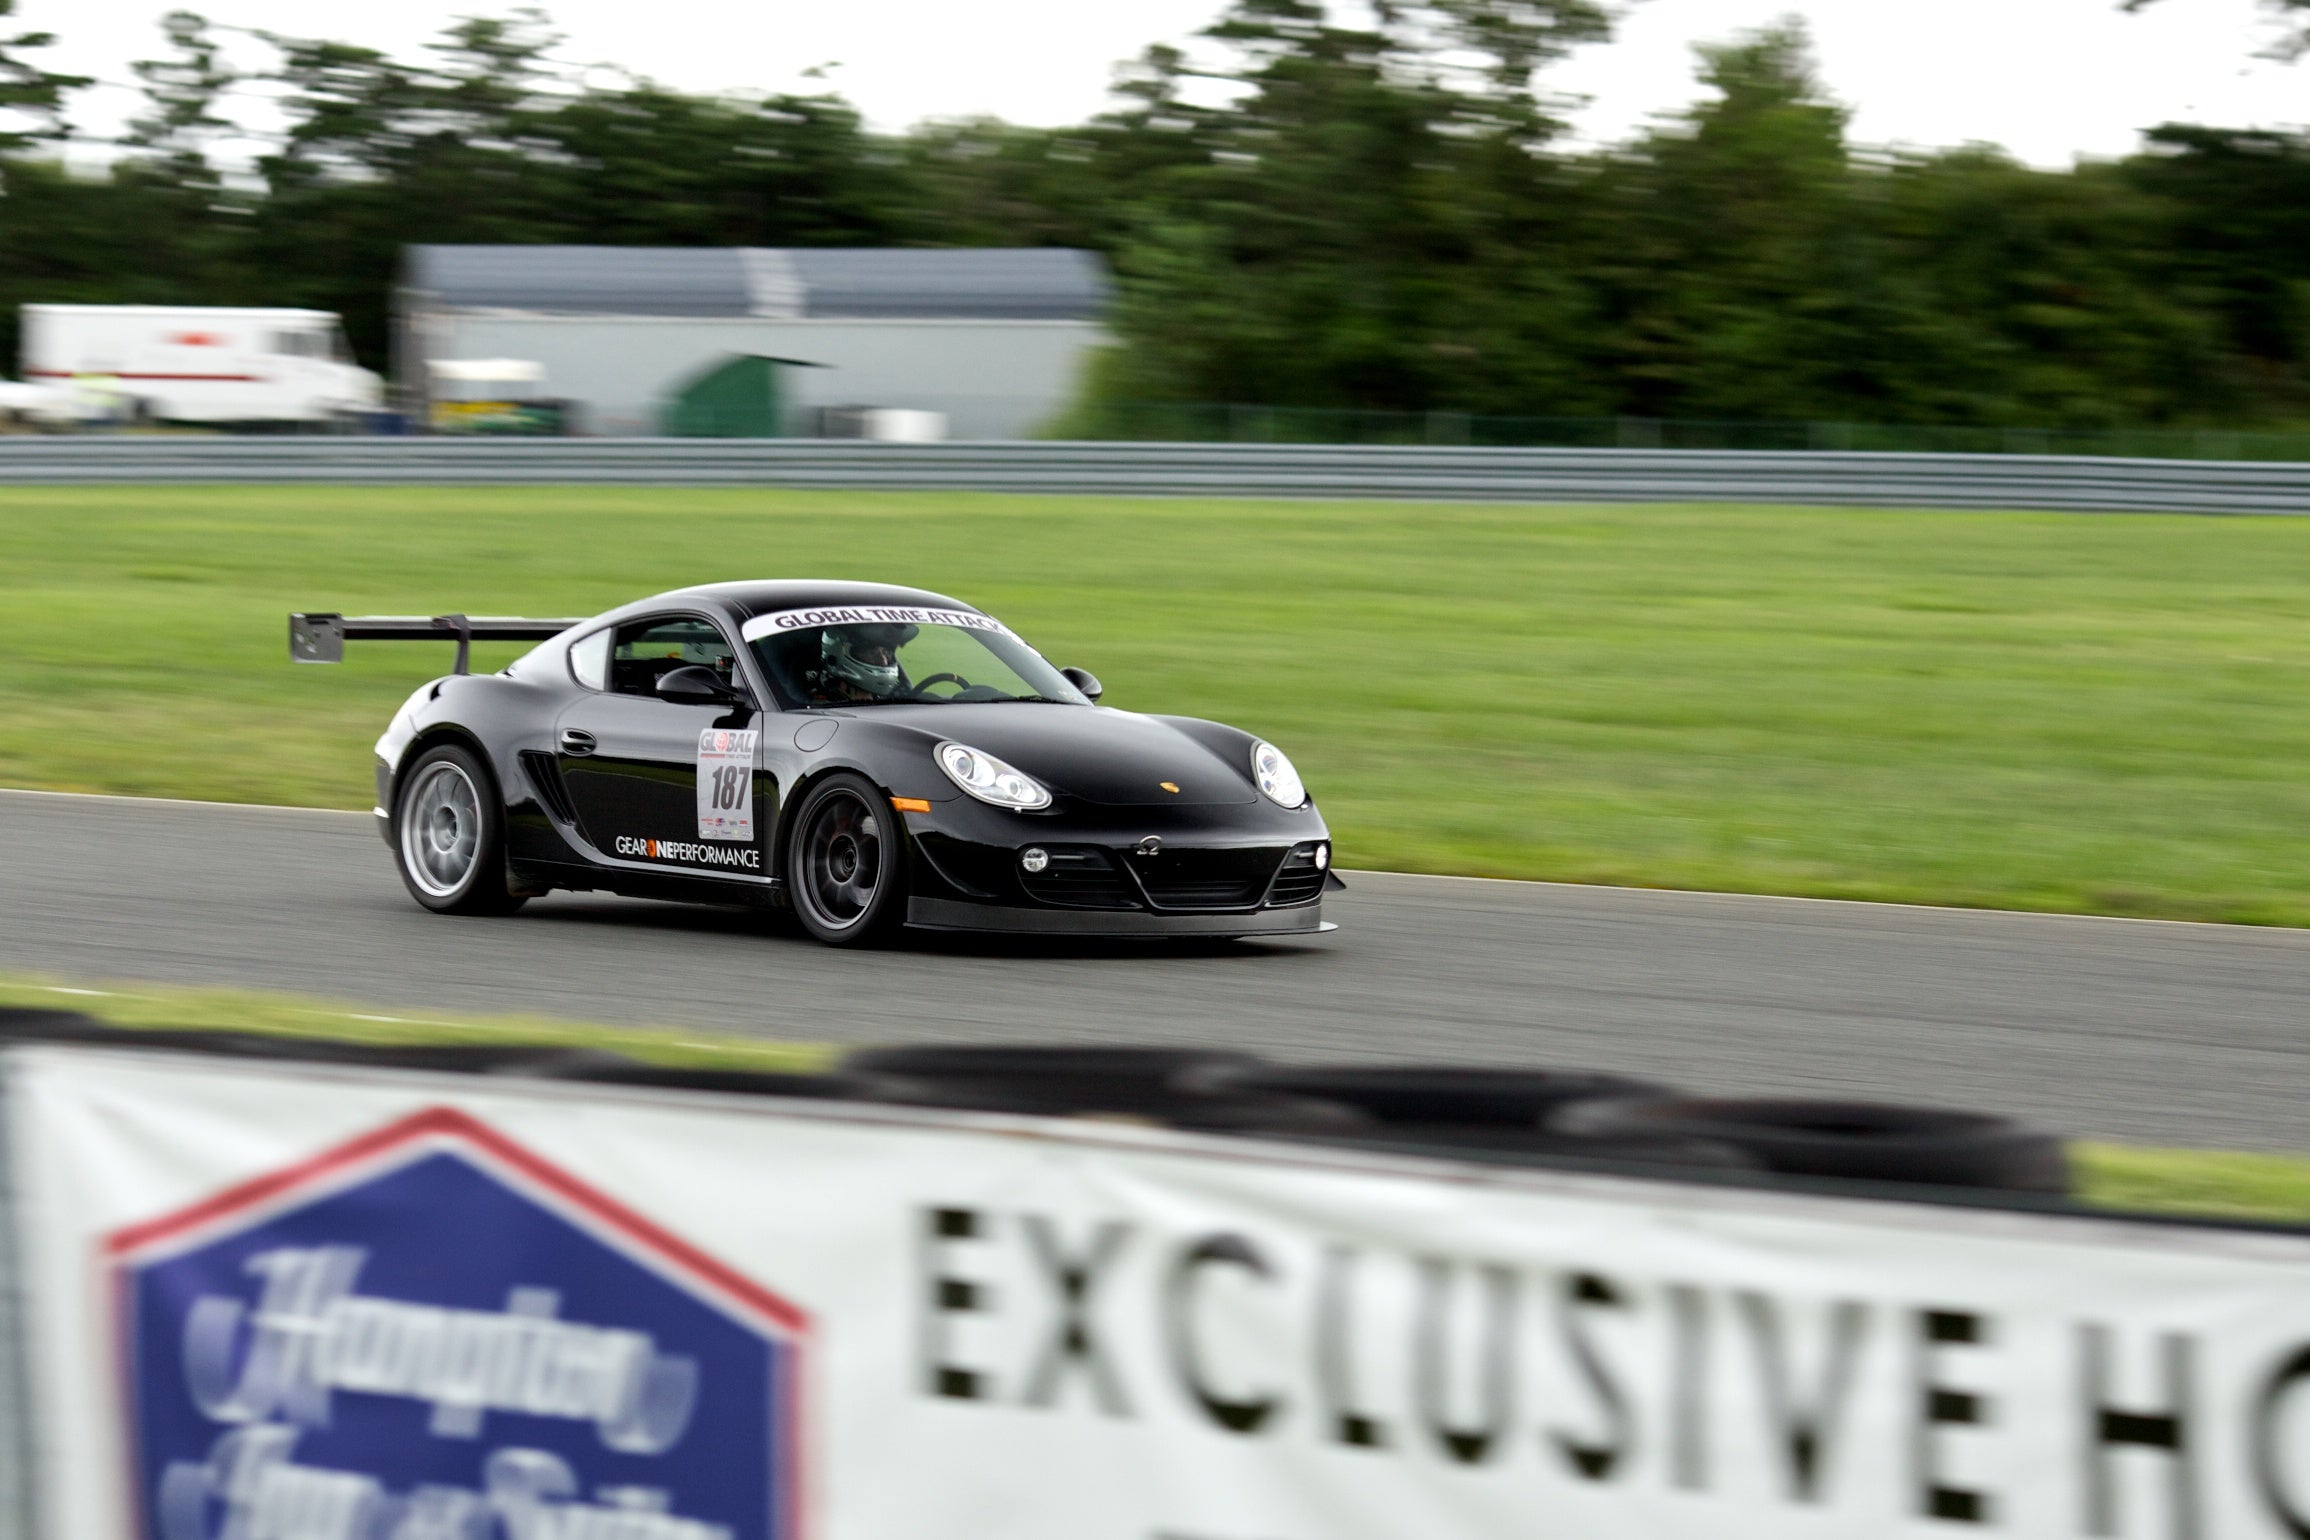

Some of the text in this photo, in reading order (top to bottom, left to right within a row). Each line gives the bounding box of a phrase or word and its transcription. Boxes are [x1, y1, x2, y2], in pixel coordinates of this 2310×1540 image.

[775, 609, 866, 629] GLOBAL
[867, 608, 927, 623] TIME
[700, 731, 752, 752] GLOBAL
[711, 765, 749, 810] 187
[918, 1205, 2000, 1525] EXCLUSIVE
